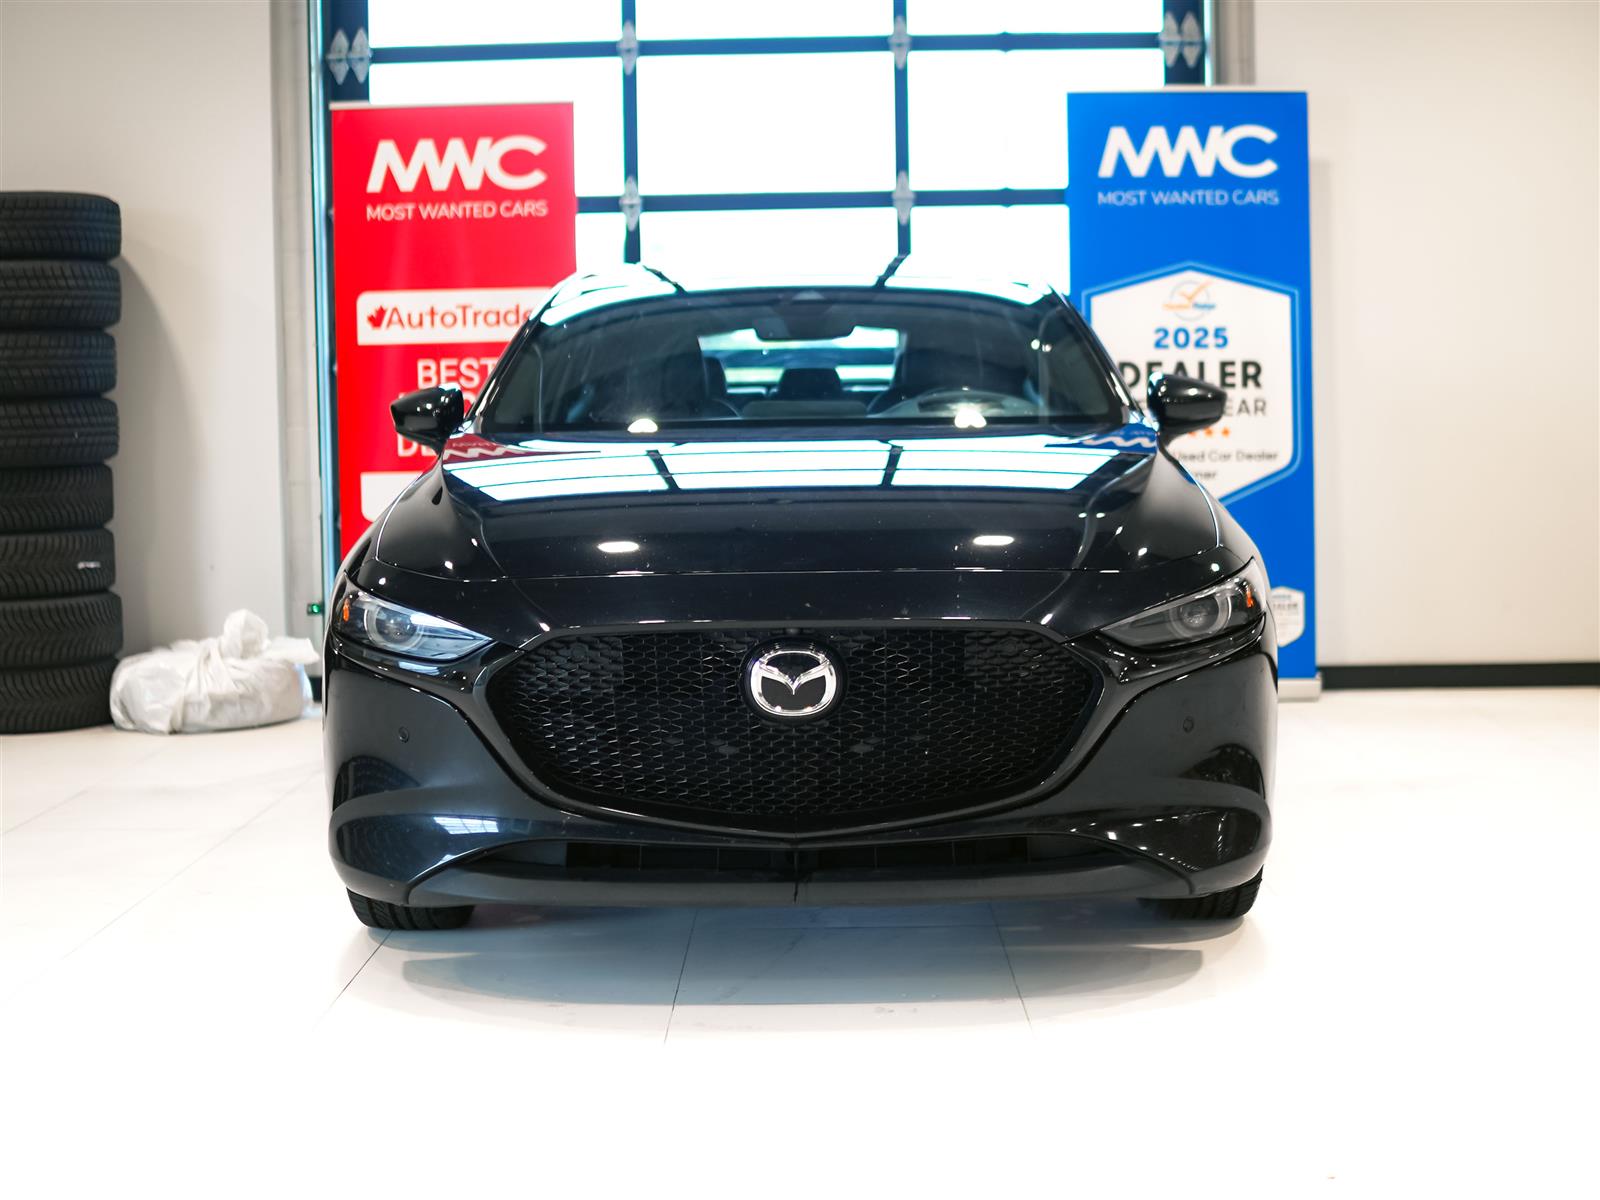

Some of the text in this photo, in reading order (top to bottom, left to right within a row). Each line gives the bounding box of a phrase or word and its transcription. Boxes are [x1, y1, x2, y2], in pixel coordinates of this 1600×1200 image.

[1098, 124, 1279, 178] MWC
[366, 134, 548, 193] MWC
[1097, 189, 1280, 206] MOST WANTED CARS
[366, 199, 549, 221] MOST WANTED CARS
[1153, 327, 1230, 349] 2025
[417, 357, 501, 389] BEST
[1223, 399, 1267, 416] EAR
[1207, 450, 1232, 462] Car
[1235, 449, 1279, 462] Dealer
